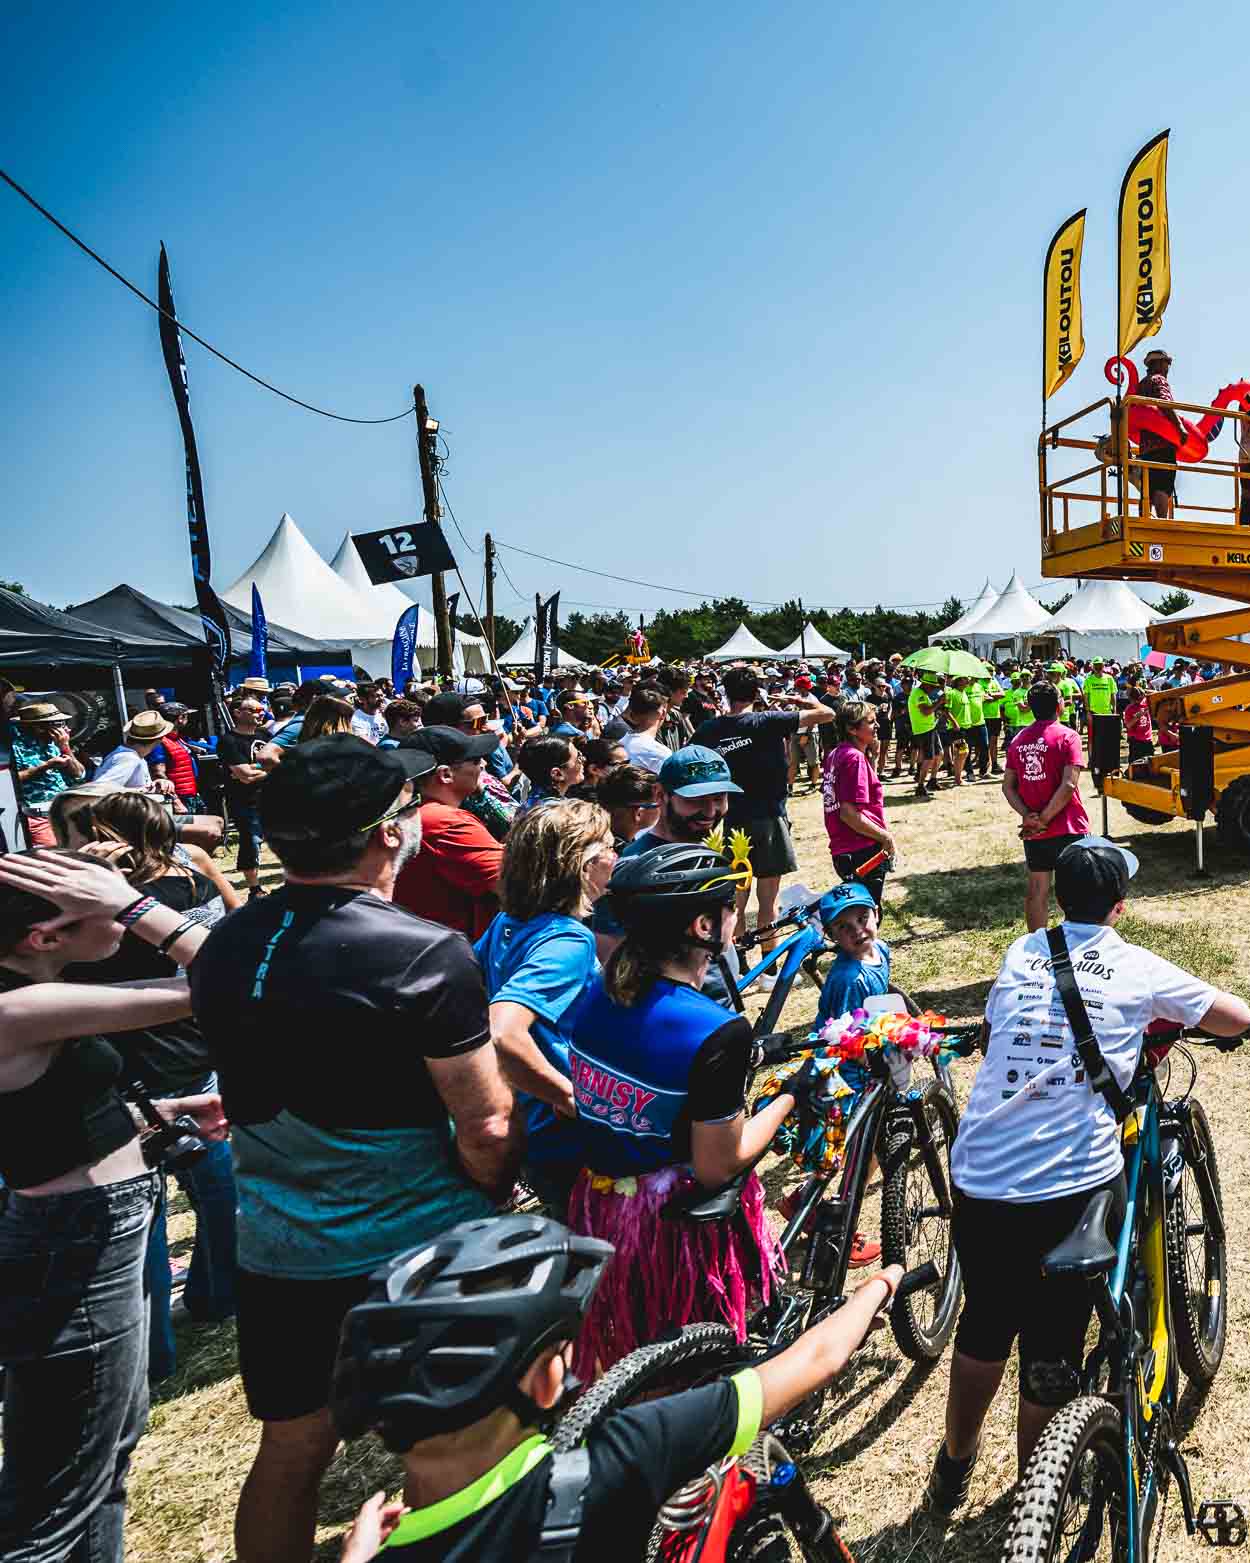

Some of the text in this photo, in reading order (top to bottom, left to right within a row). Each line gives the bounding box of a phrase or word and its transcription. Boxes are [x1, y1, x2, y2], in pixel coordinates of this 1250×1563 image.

[379, 532, 417, 555] 12
[251, 910, 295, 1000] ULTRA
[1031, 959, 1114, 980] CRAUDS
